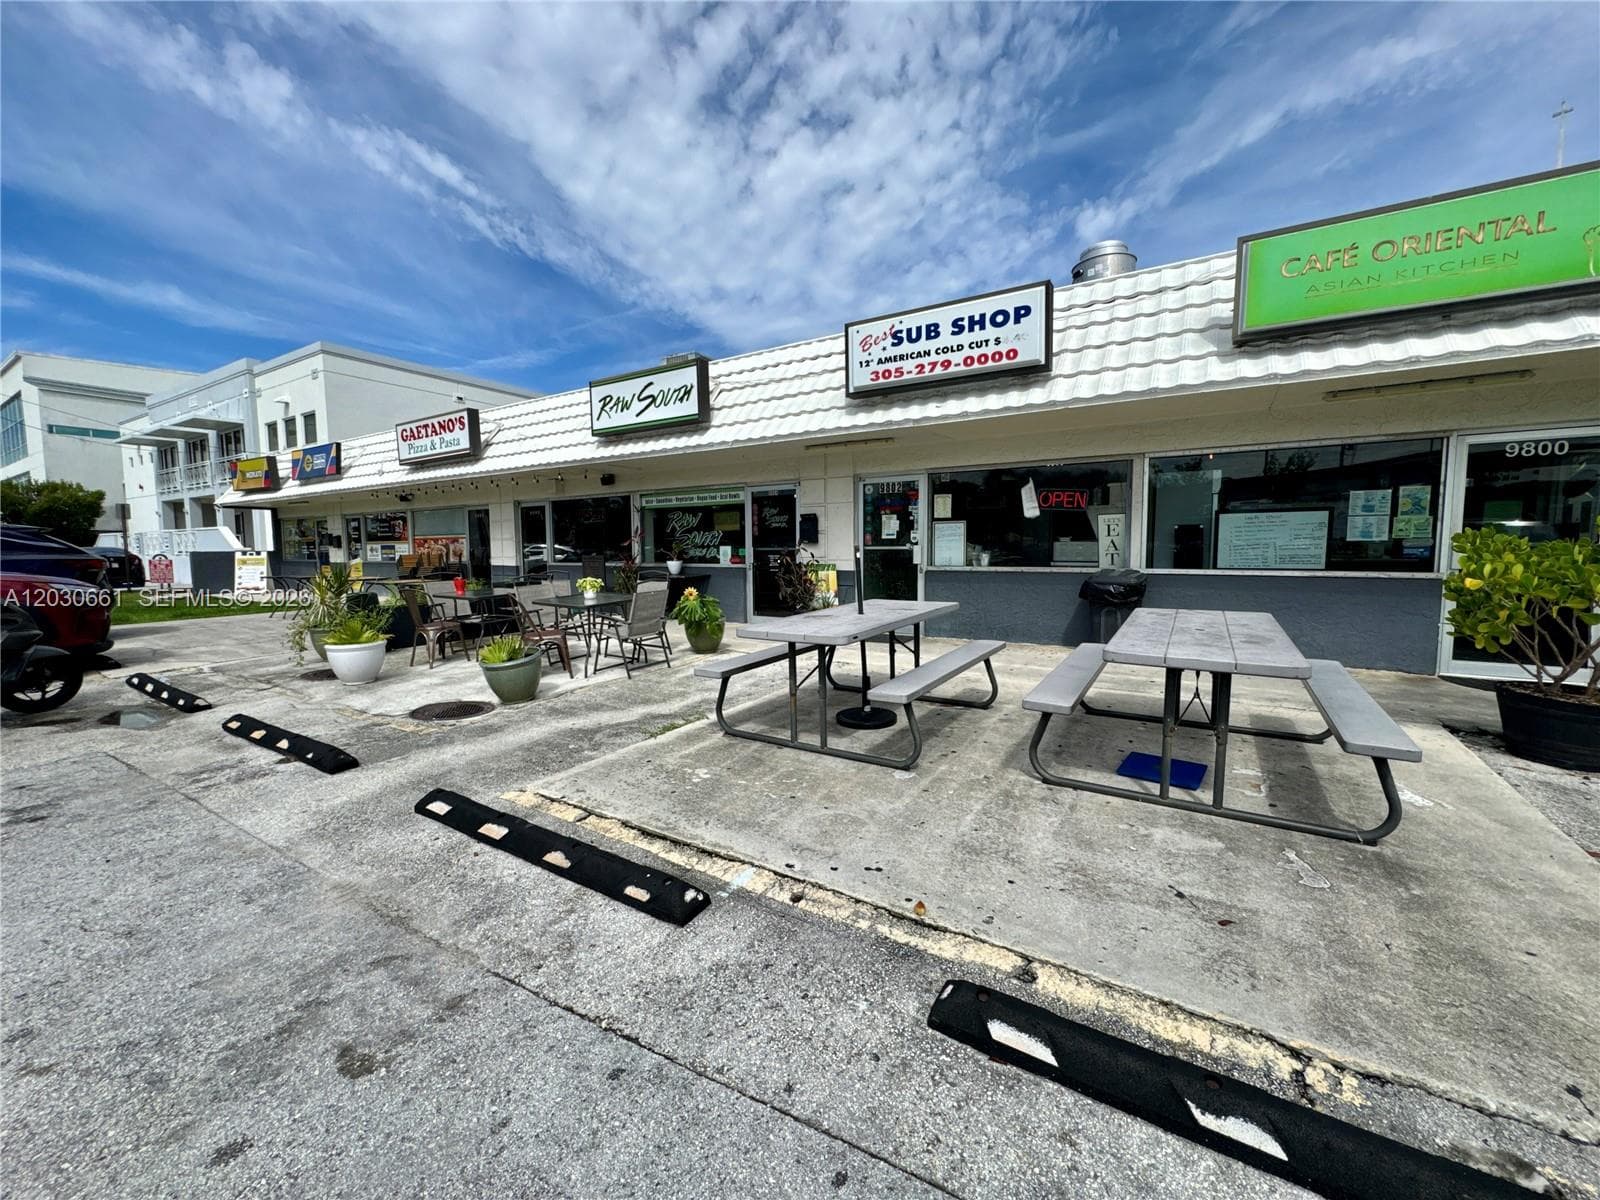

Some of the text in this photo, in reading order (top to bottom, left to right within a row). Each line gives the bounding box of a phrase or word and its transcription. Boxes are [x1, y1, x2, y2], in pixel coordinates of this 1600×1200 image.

[1280, 211, 1557, 278] CAFÉ ORIENTAL
[1305, 251, 1520, 295] ASIAN KITCHEN
[860, 324, 896, 352] Best
[891, 322, 941, 347] SUB
[950, 305, 1032, 336] SHOP
[869, 348, 1019, 383] 305-279-0000
[876, 350, 931, 366] AMERICAN
[935, 344, 964, 356] COLD
[968, 339, 991, 350] CUT
[597, 381, 693, 421] RAW SOUTH
[400, 415, 466, 443] GAETANO'S
[408, 436, 461, 455] Pizza & Pasta
[1505, 440, 1570, 457] 9800
[880, 481, 903, 493] 9802
[1040, 491, 1088, 508] OPEN
[1105, 523, 1120, 566] EAT
